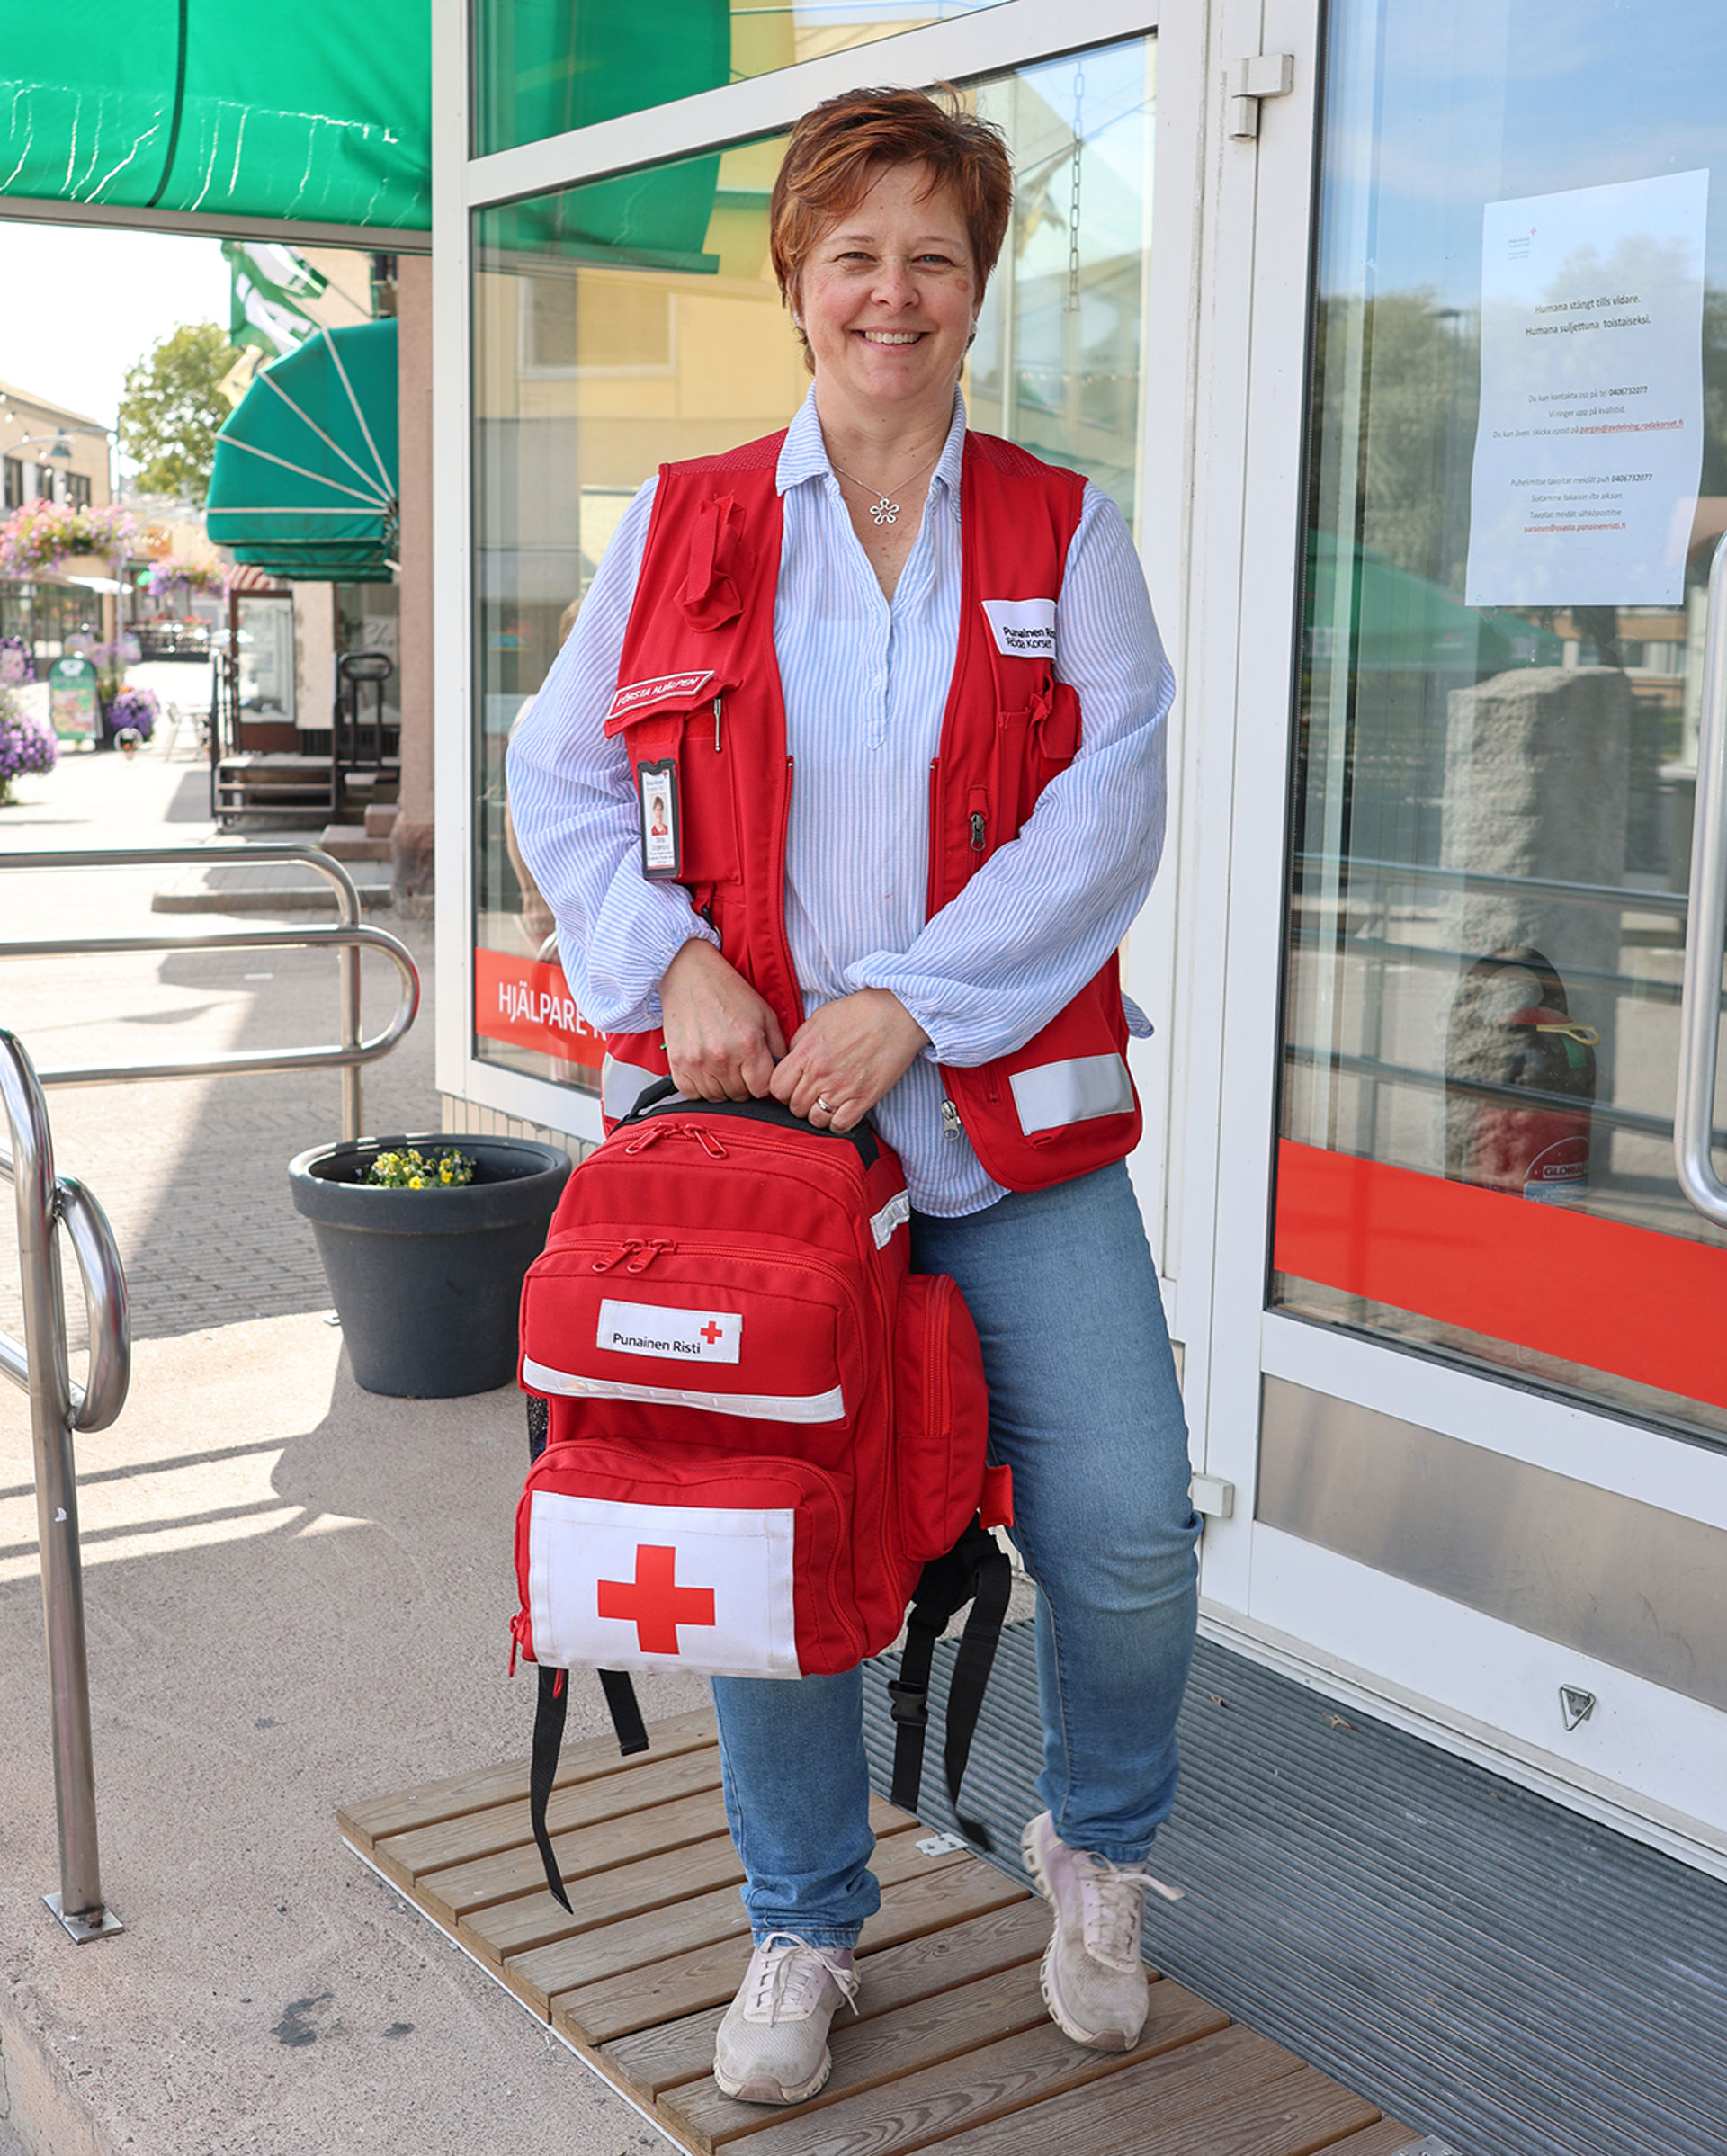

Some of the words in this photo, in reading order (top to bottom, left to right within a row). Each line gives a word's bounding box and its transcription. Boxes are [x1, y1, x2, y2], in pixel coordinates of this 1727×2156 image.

[1535, 304, 1568, 314] Humana
[1596, 297, 1611, 308] tills
[1612, 294, 1641, 305] vidare.
[1526, 325, 1558, 336] Humana
[1559, 321, 1599, 335] suljettuna
[1603, 314, 1651, 329] toistaiseksi.
[1528, 394, 1536, 403] Du
[1538, 392, 1550, 402] kan
[1551, 390, 1578, 401] kontakta
[1003, 626, 1044, 638] Punainen
[616, 687, 651, 707] FÖRSTA
[651, 676, 700, 695] HJÄLPEN
[613, 1332, 670, 1351] Punainen
[673, 1340, 701, 1354] Risti
